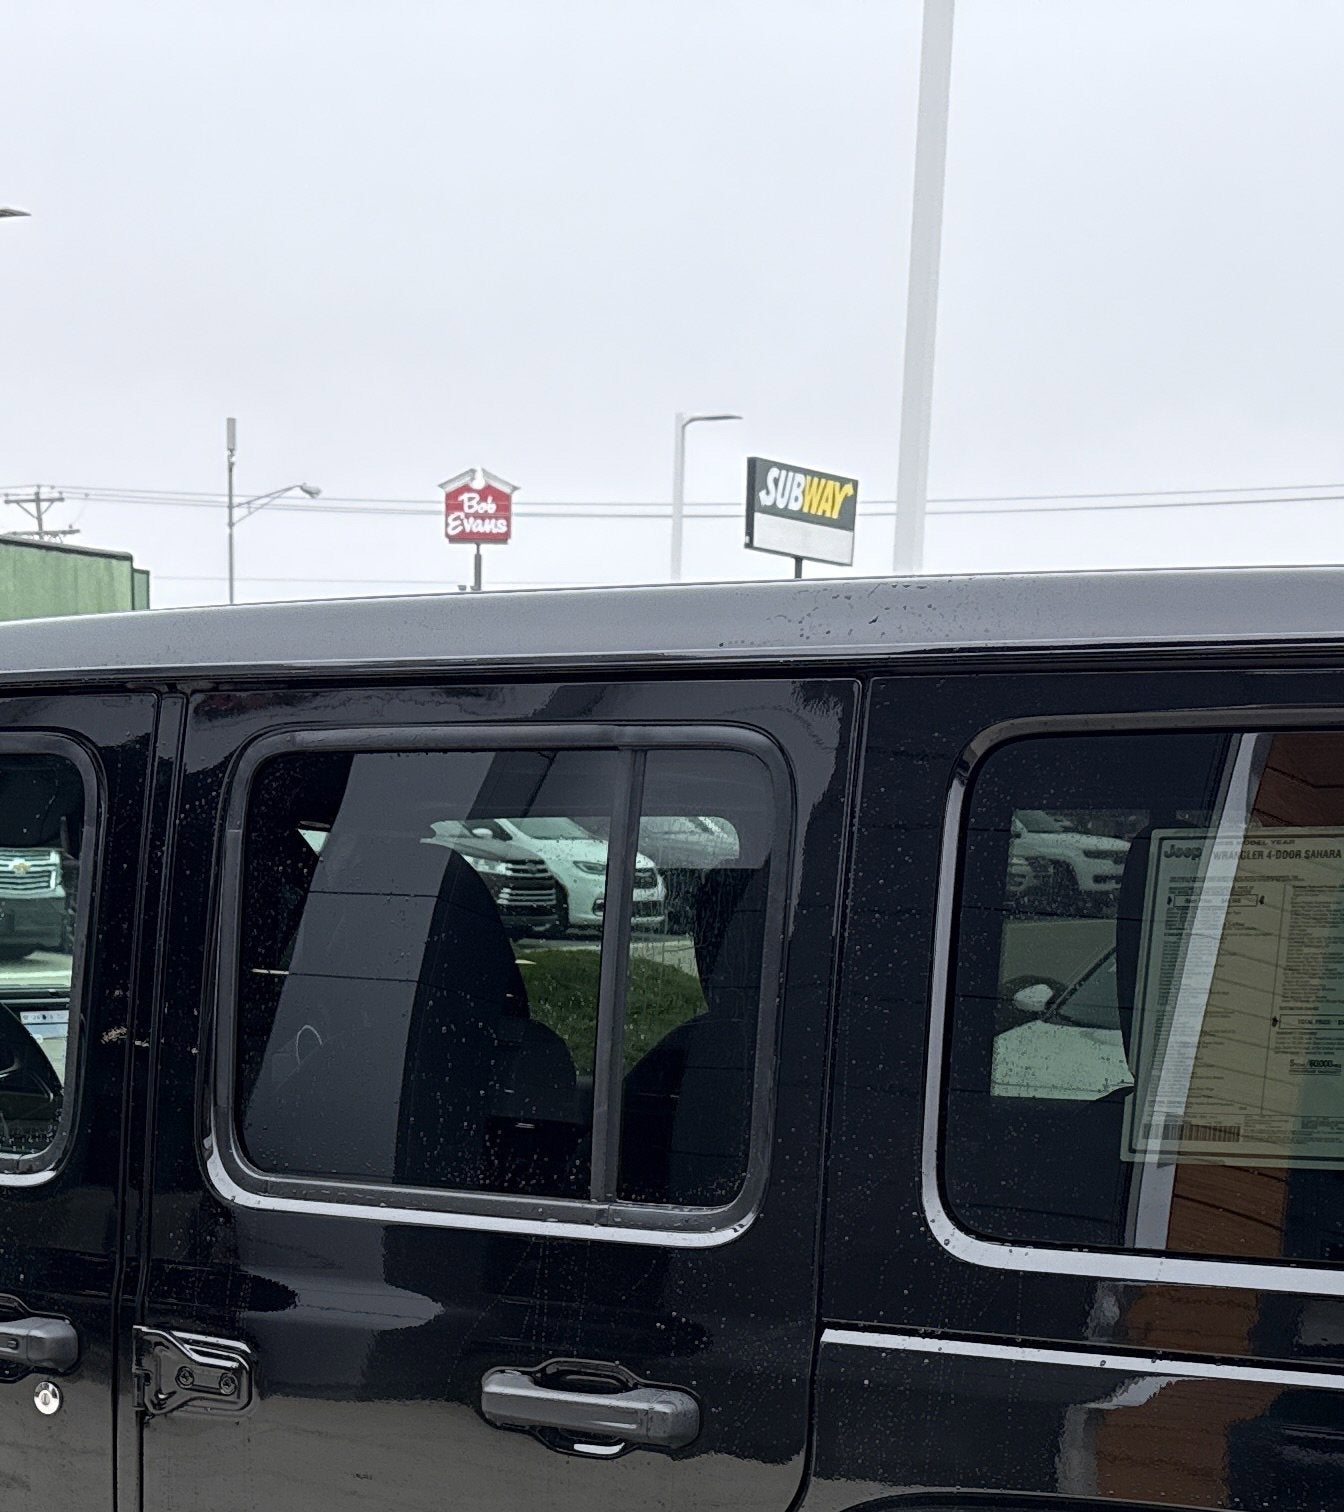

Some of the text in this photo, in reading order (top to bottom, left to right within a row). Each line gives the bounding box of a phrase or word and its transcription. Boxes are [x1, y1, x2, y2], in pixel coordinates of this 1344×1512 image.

[458, 492, 497, 514] Bob
[759, 467, 854, 519] SUBWAY
[447, 512, 508, 536] Evans
[1164, 844, 1203, 861] Jeep
[1266, 849, 1302, 860] 4-DOOR
[1304, 849, 1342, 860] SAHARA
